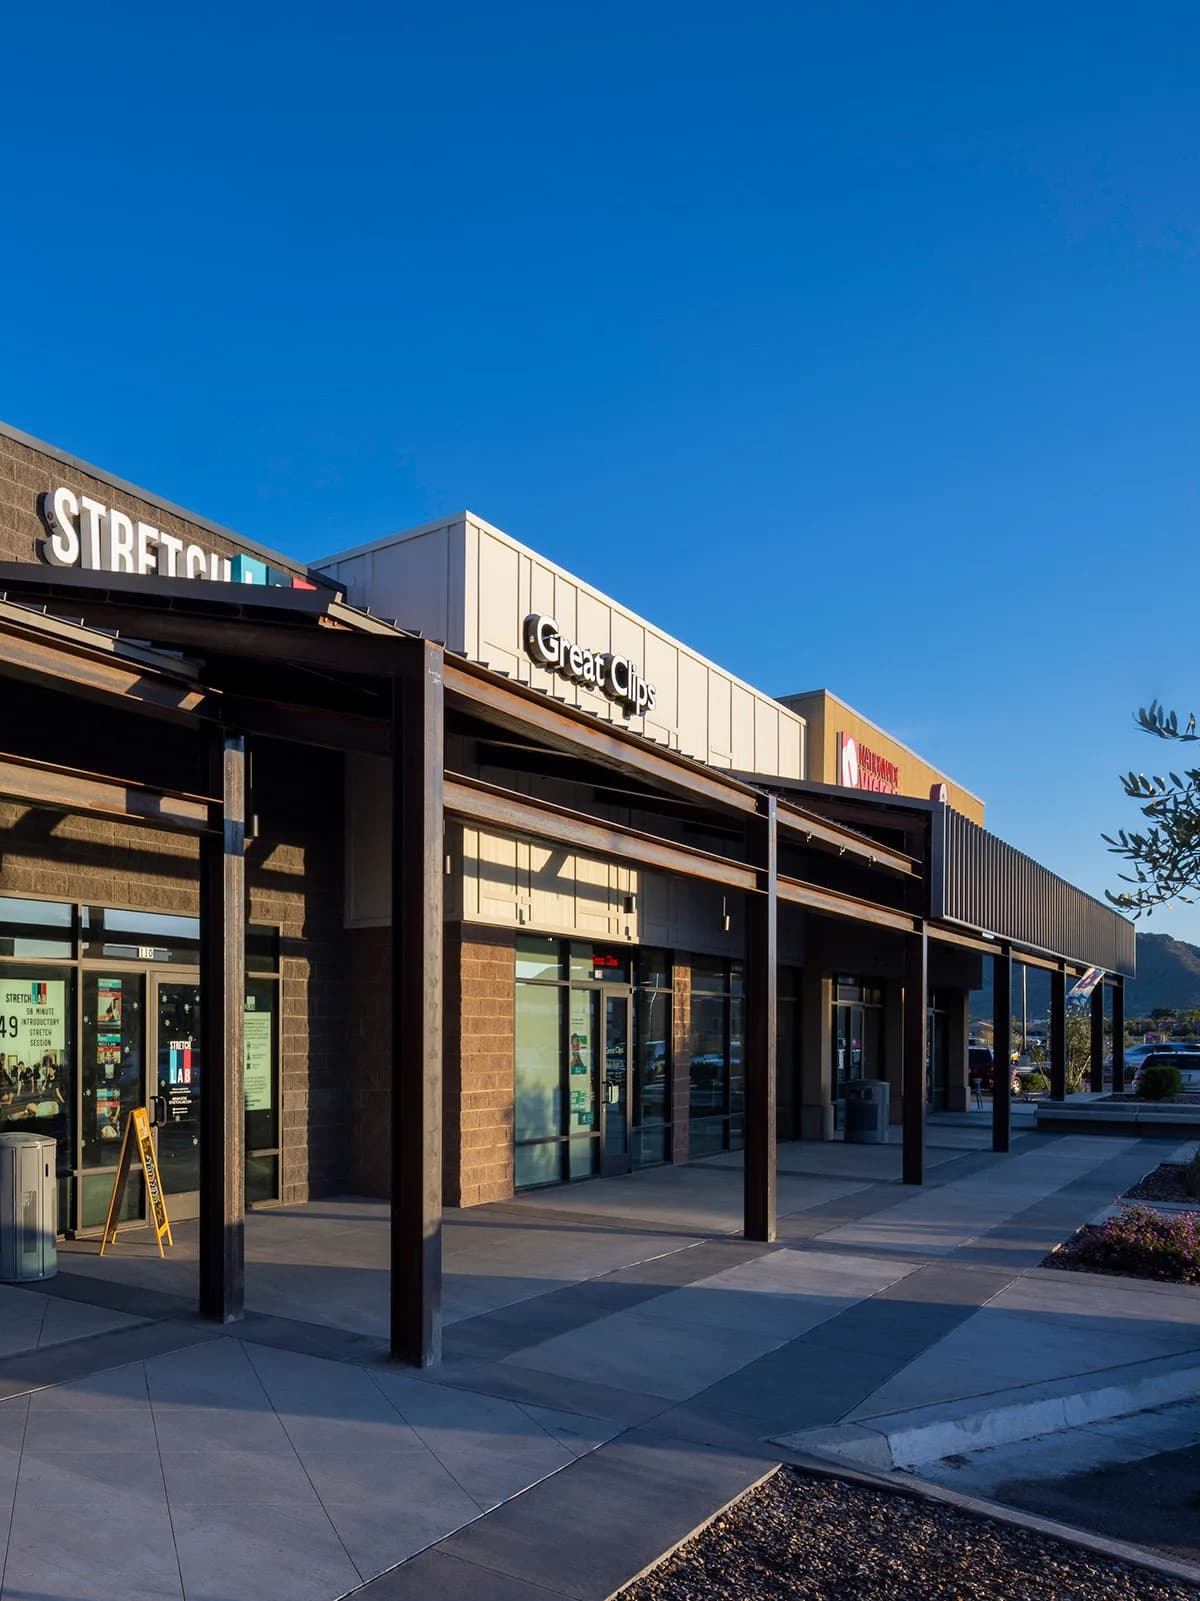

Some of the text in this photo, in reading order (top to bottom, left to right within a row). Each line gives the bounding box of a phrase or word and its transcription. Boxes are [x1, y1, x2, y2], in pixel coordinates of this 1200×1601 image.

[528, 614, 656, 716] Great Clips
[170, 1068, 191, 1084] LAB
